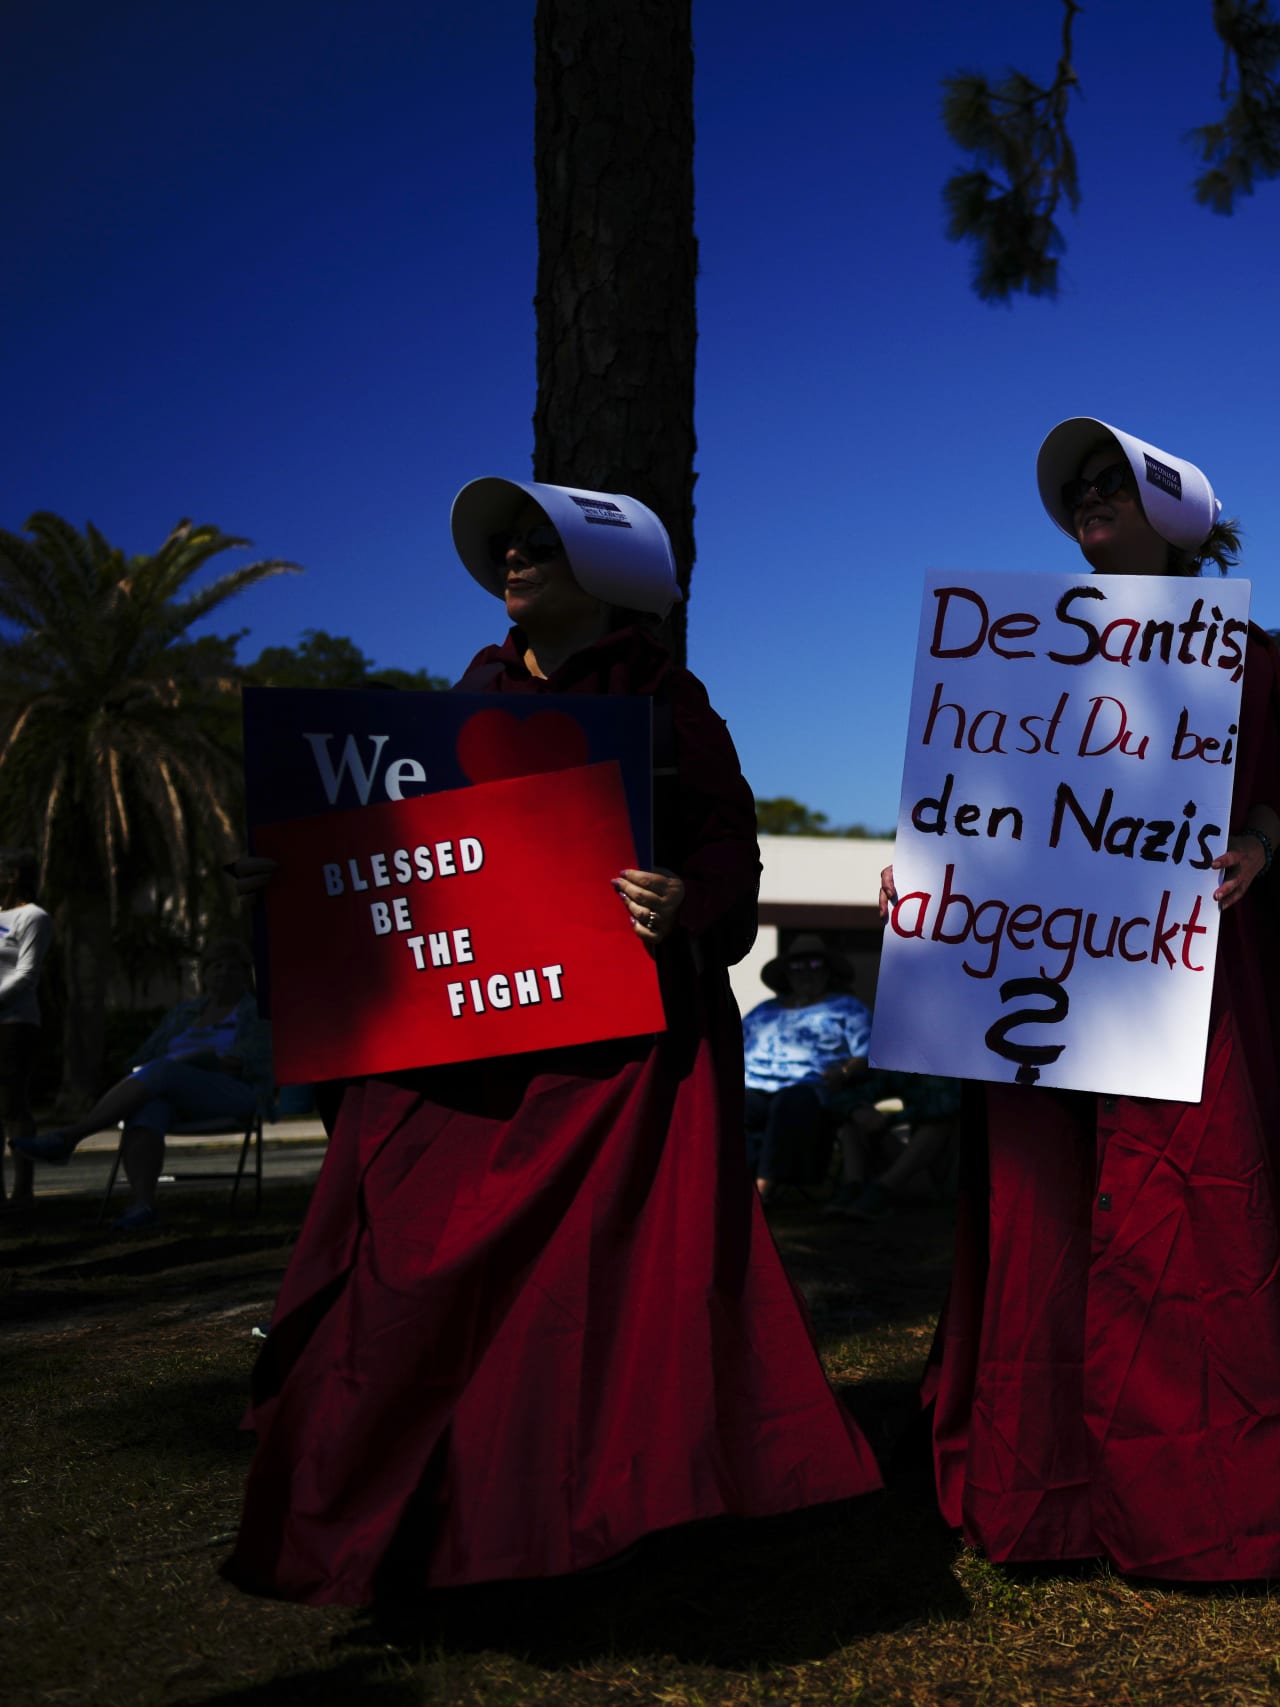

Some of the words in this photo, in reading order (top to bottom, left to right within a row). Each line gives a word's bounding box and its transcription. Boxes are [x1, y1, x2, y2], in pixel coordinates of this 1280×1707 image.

[922, 683, 1070, 754] hast
[1078, 696, 1149, 760] Du
[1171, 706, 1238, 765] bei
[302, 732, 427, 807] We
[912, 773, 1022, 840] den
[1049, 782, 1222, 870] Nazis
[323, 837, 485, 897] BLESSED
[370, 897, 413, 935] BE
[407, 928, 474, 970] THE
[891, 864, 1208, 984] abgeguckt
[447, 964, 563, 1017] FIGHT
